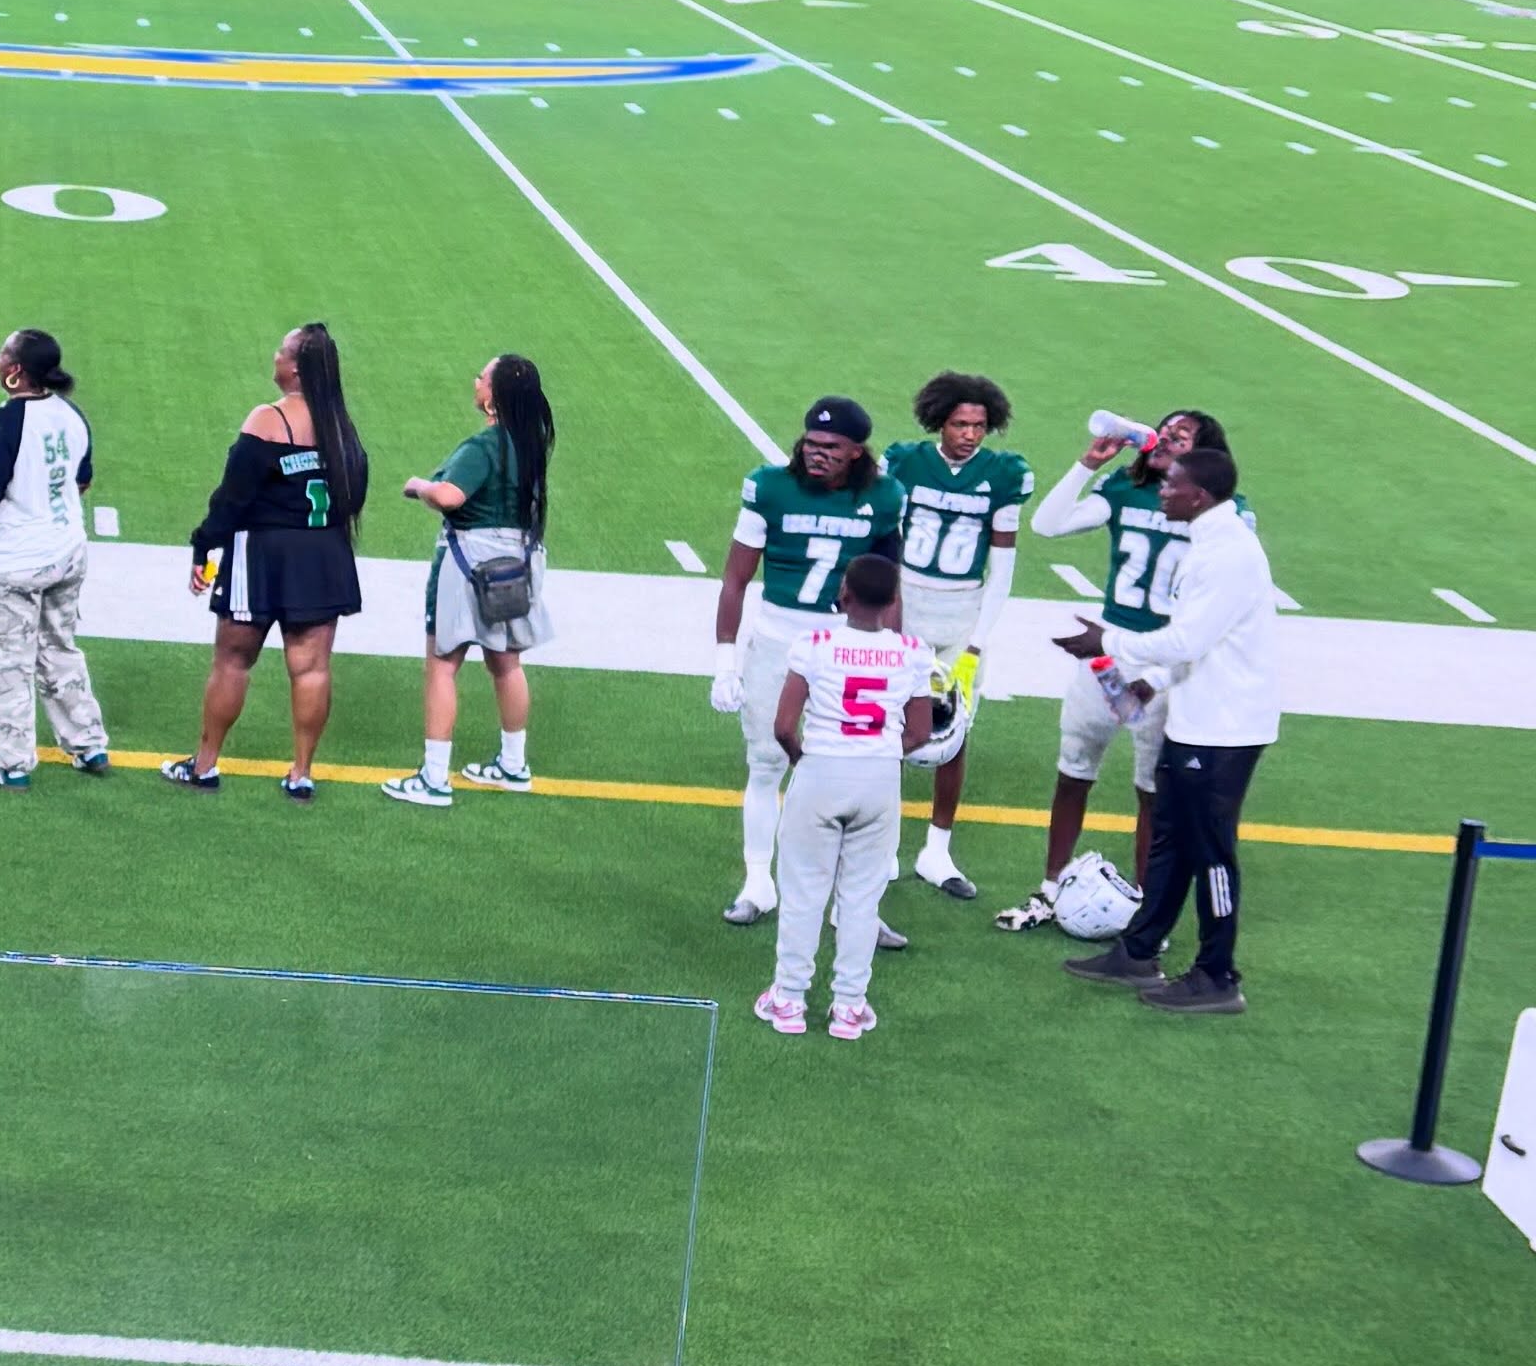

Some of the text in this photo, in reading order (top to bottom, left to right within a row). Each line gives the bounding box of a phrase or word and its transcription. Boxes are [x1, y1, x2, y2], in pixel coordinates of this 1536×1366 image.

[797, 537, 842, 604] 7
[833, 647, 906, 668] FREDERICK
[840, 676, 888, 736] 5
